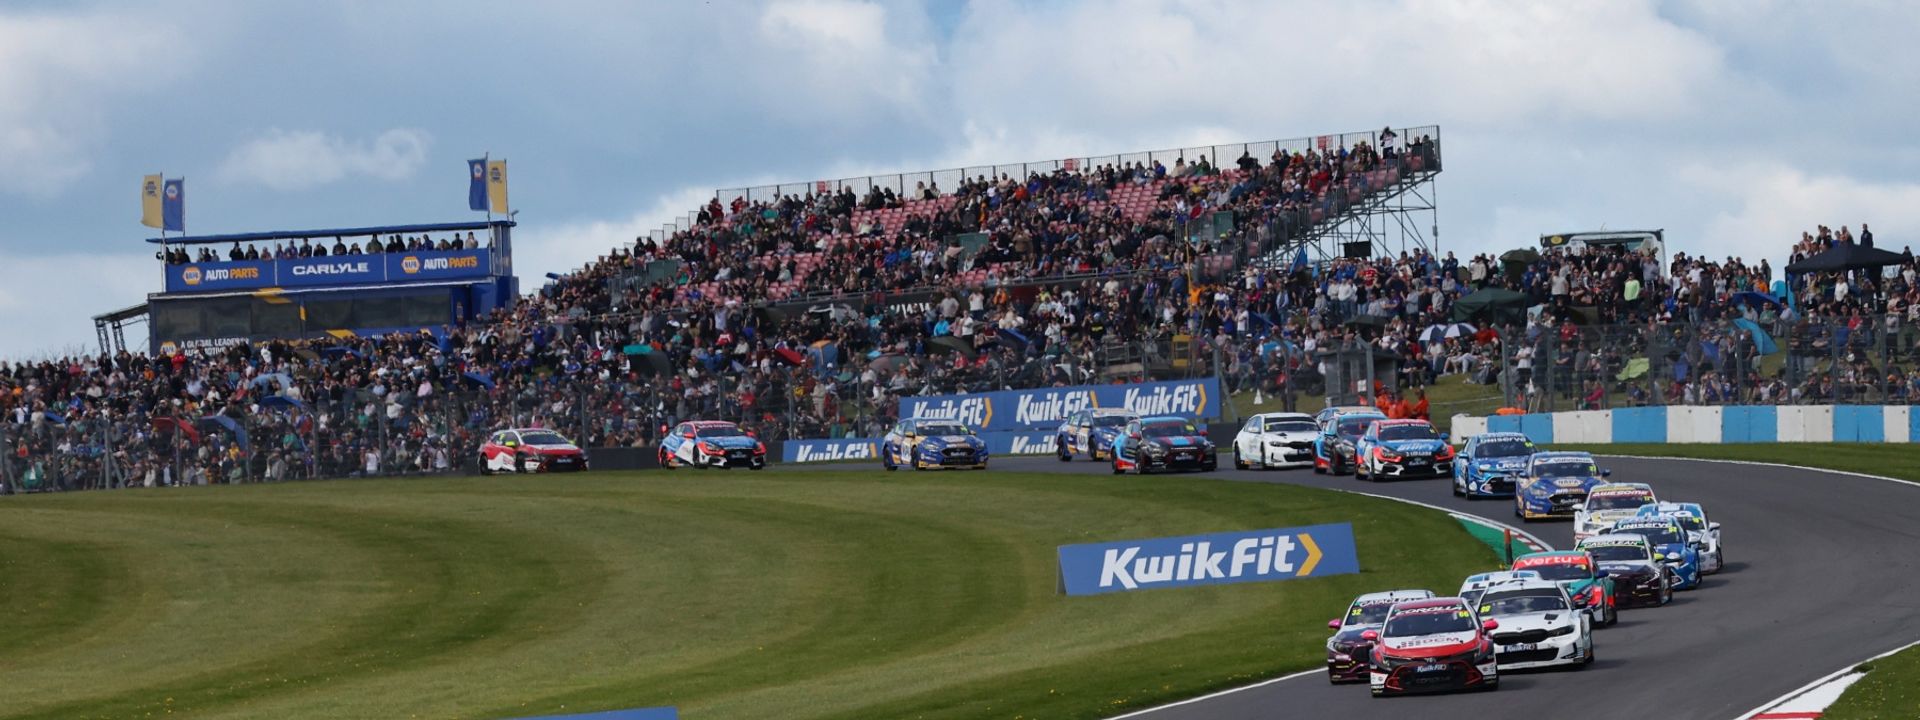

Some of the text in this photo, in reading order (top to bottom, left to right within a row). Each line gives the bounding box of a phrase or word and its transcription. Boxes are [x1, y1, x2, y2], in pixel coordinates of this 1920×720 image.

[292, 262, 369, 275] CARLYLE
[424, 258, 448, 270] AUTO
[448, 256, 478, 268] PARTS
[205, 269, 229, 281] AUTO
[230, 267, 258, 279] PARTS
[1352, 607, 1362, 616] 32
[1395, 606, 1462, 617] COROLLA
[1459, 610, 1469, 618] 66
